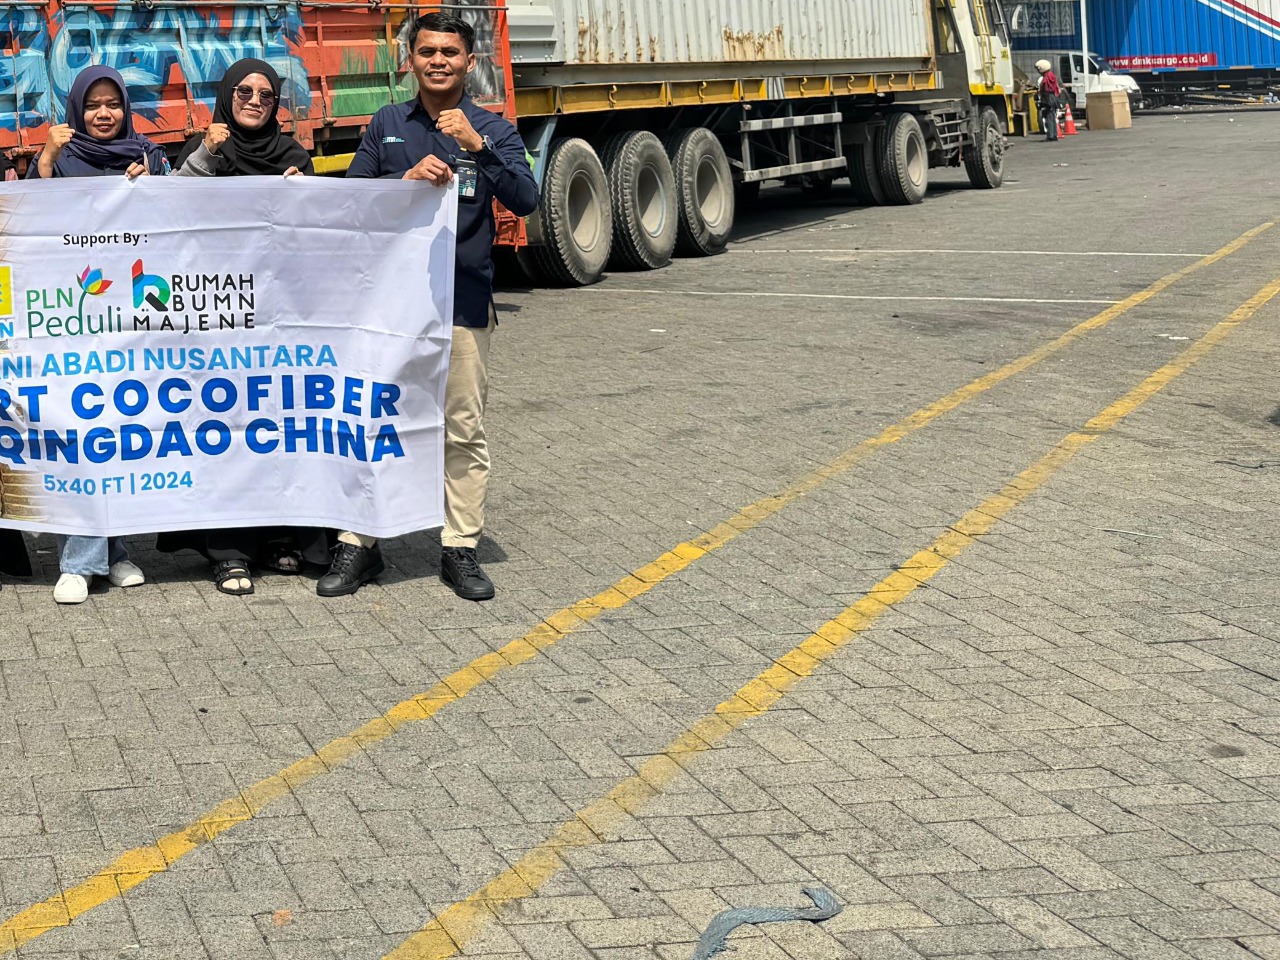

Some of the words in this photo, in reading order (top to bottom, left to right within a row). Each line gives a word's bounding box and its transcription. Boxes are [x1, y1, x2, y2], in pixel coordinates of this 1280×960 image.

[63, 232, 119, 248] Support
[123, 232, 139, 246] By
[172, 273, 254, 292] RUMAH
[26, 287, 73, 310] PLN
[172, 293, 255, 312] BUMN
[28, 305, 122, 338] Peduli
[133, 312, 255, 334] MAJENE
[41, 348, 135, 377] ABADI
[144, 344, 338, 371] NUSANTARA
[71, 374, 401, 420] COCOFIBER
[245, 416, 406, 463] CHINA
[43, 474, 96, 496] 5x40
[101, 476, 125, 495] FT
[140, 470, 193, 491] 2024
